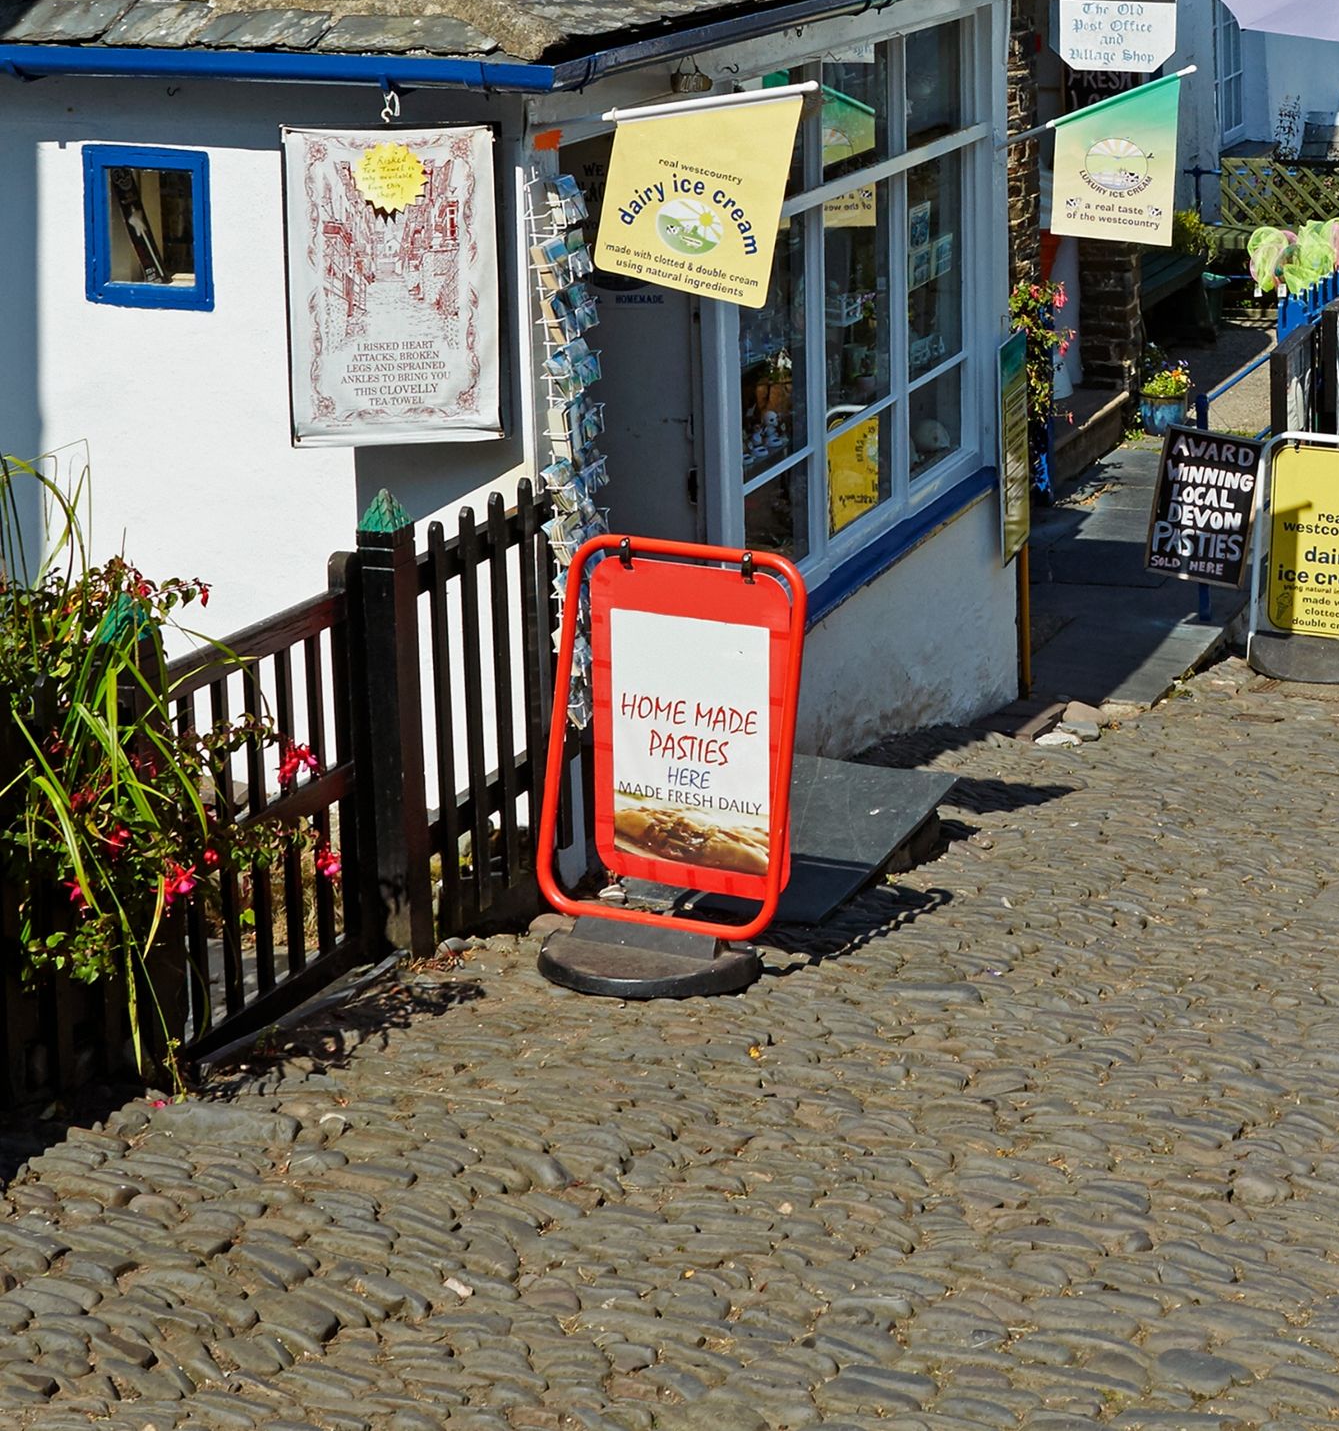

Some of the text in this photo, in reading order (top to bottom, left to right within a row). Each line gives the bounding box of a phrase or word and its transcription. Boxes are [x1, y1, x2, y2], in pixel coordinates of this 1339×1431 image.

[1082, 3, 1143, 15] The Old
[1072, 19, 1152, 32] Post Office
[1100, 33, 1123, 45] and
[1069, 48, 1154, 65] Village Shop
[659, 158, 742, 185] real westcountry
[1079, 170, 1107, 195] LUXURY
[1127, 176, 1152, 196] CREAM
[618, 182, 664, 225] dairy
[673, 173, 705, 195] ice
[713, 190, 757, 255] cream
[1118, 206, 1143, 215] taste
[1080, 213, 1095, 221] the
[1099, 216, 1160, 230] westcountry
[634, 250, 651, 260] with
[654, 255, 685, 269] clotted
[688, 263, 693, 271] &
[696, 267, 727, 279] double
[730, 275, 758, 287] cream
[616, 260, 743, 297] using natural ingredients
[616, 294, 663, 304] HOMEMADE
[364, 342, 399, 351] RISKED
[402, 341, 433, 349] HEART
[352, 351, 439, 362] ATTACKS, BROKEN
[347, 361, 445, 373] LEGS AND SPRAINED
[341, 371, 451, 384] ANKLES TO BRING YOU
[355, 383, 438, 396] THIS CLOVELLY
[1172, 435, 1254, 467] AWARD
[1166, 459, 1254, 492] WINNING
[1171, 483, 1235, 509] LOCAL
[1167, 502, 1242, 530] DEVON
[1152, 520, 1243, 561] PASTIES
[1150, 555, 1224, 575] SOLD HERE
[1278, 564, 1309, 583] ice
[1284, 584, 1303, 592] using
[1302, 597, 1331, 605] made
[1292, 617, 1326, 628] double
[620, 692, 759, 736] HOME MADE
[648, 729, 730, 766] PASTIES
[667, 766, 711, 790] HERE
[618, 780, 763, 816] MADE FRESH DAILY
